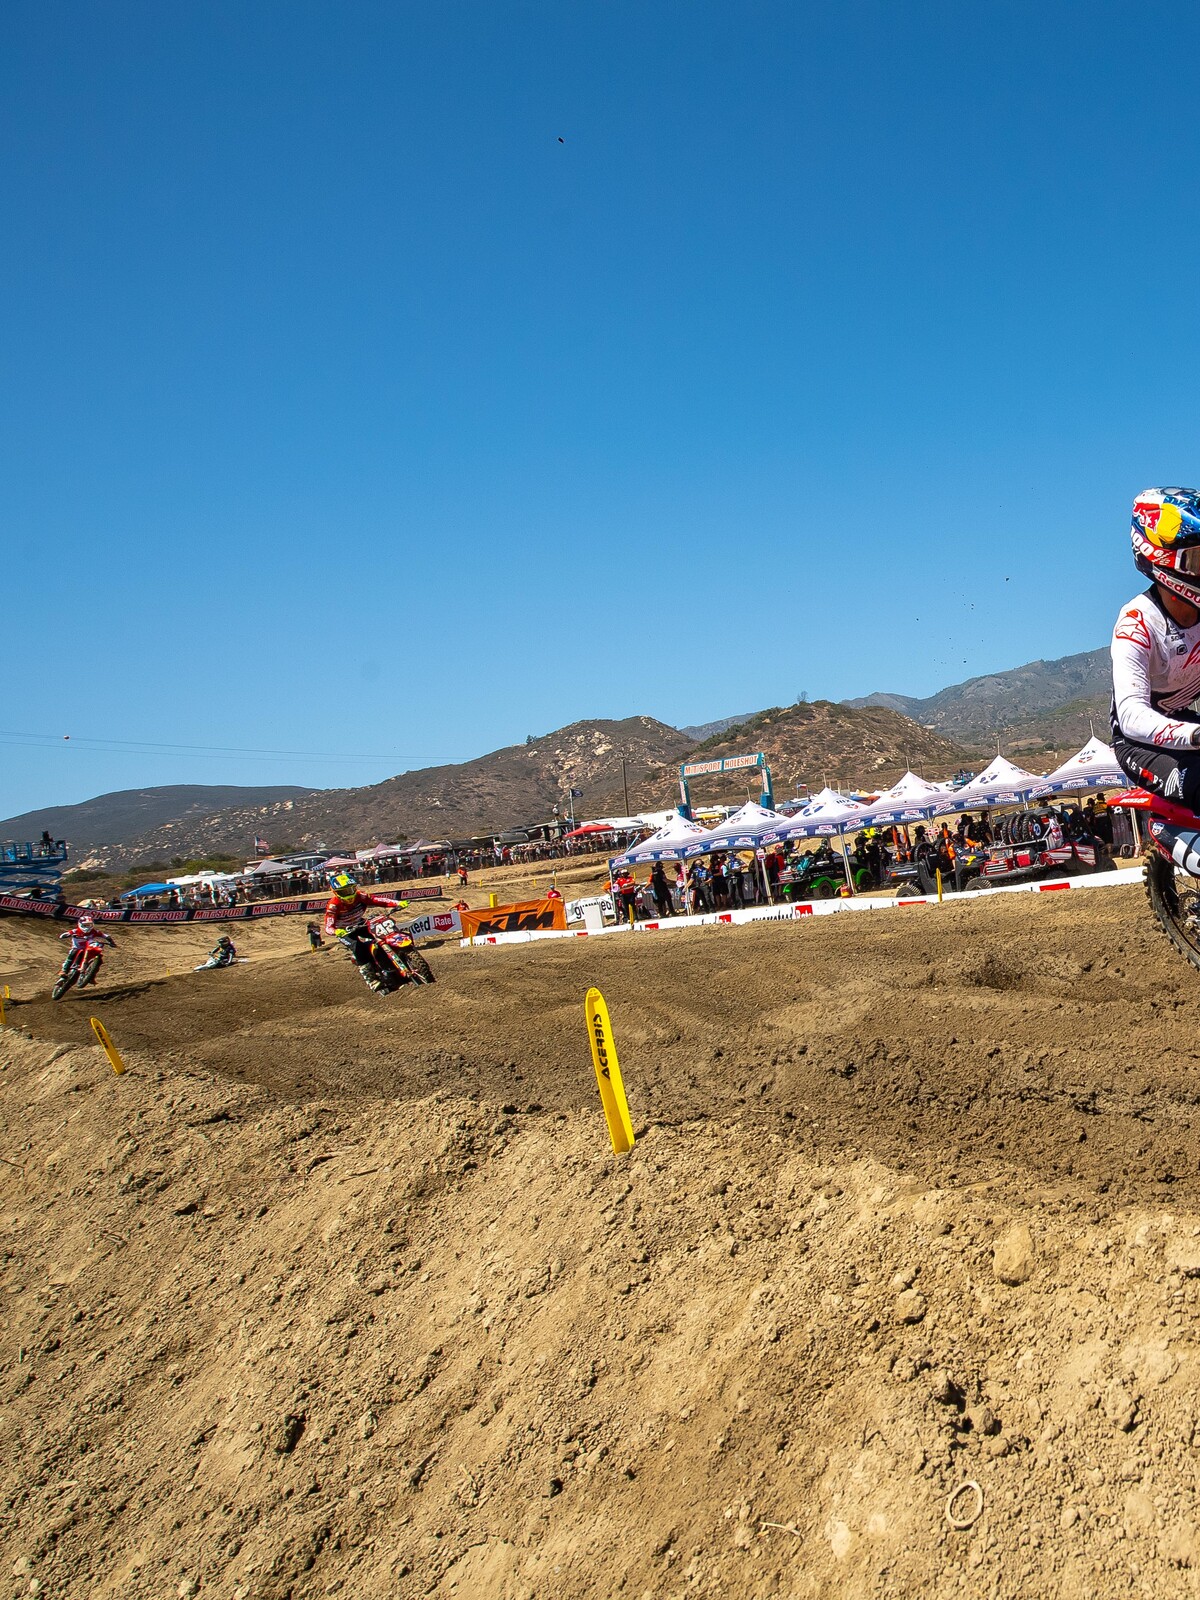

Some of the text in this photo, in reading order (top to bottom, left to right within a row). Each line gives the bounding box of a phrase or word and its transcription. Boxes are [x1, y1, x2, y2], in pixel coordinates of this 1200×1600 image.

[1158, 572, 1184, 594] Red
[725, 756, 758, 768] HOLESHOT
[375, 920, 394, 936] 42
[476, 909, 554, 936] KTM
[593, 1013, 611, 1080] ACERBIS
